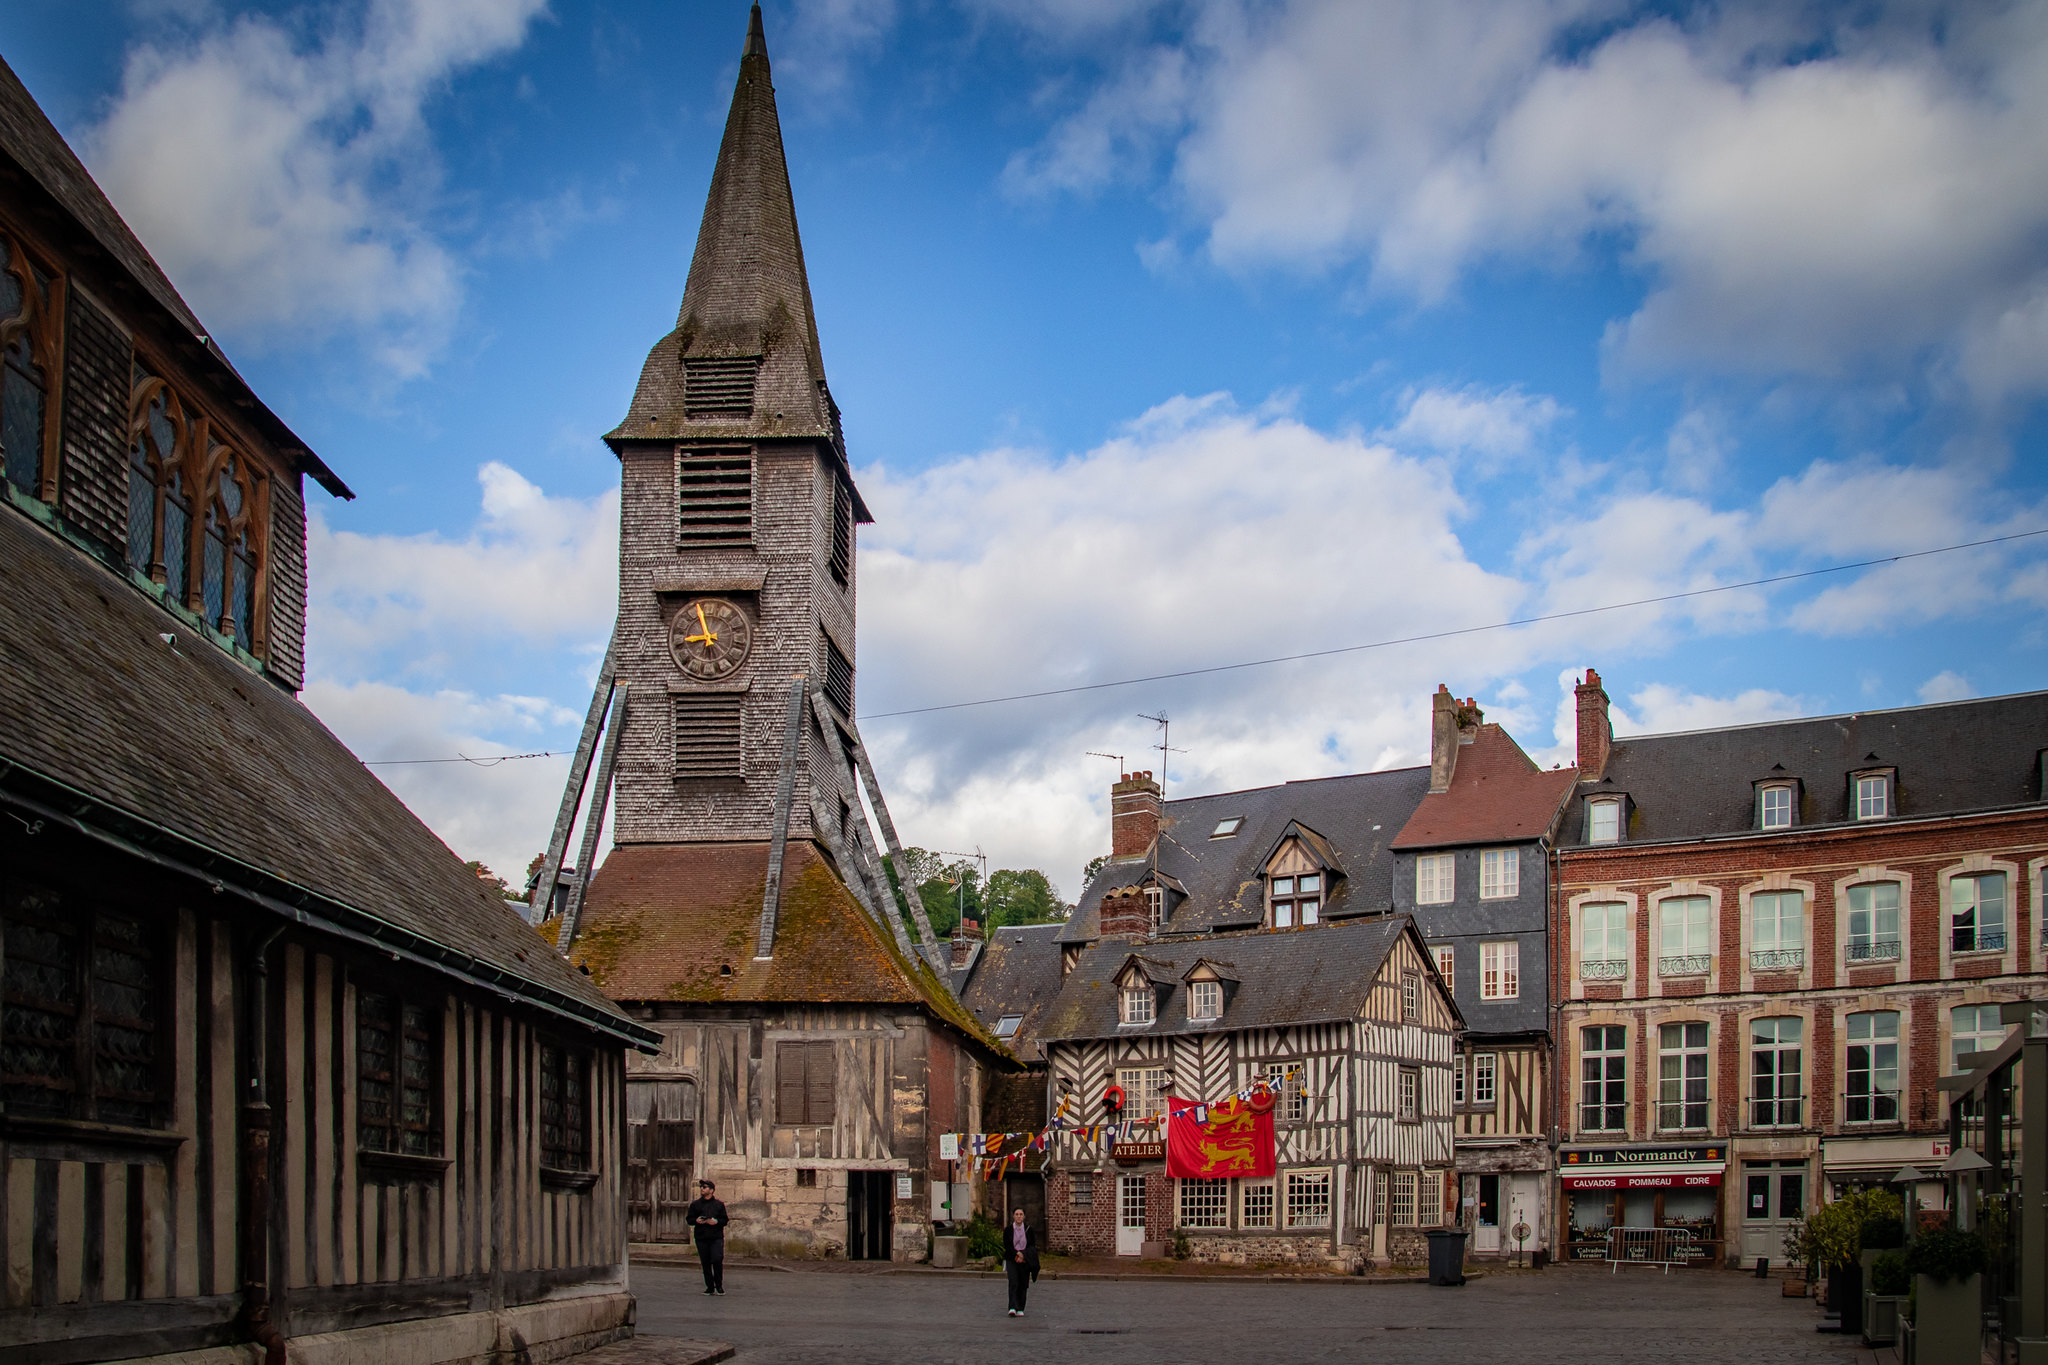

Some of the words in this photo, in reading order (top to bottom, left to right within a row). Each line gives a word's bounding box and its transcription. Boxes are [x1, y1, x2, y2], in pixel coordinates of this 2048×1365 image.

[1114, 1145, 1162, 1156] ATELIER
[1588, 1152, 1604, 1163] In
[1614, 1149, 1697, 1162] Normandy
[1573, 1179, 1616, 1188] CALVADOS
[1629, 1177, 1672, 1186] POMMEAU
[1685, 1176, 1710, 1185] CIDRE
